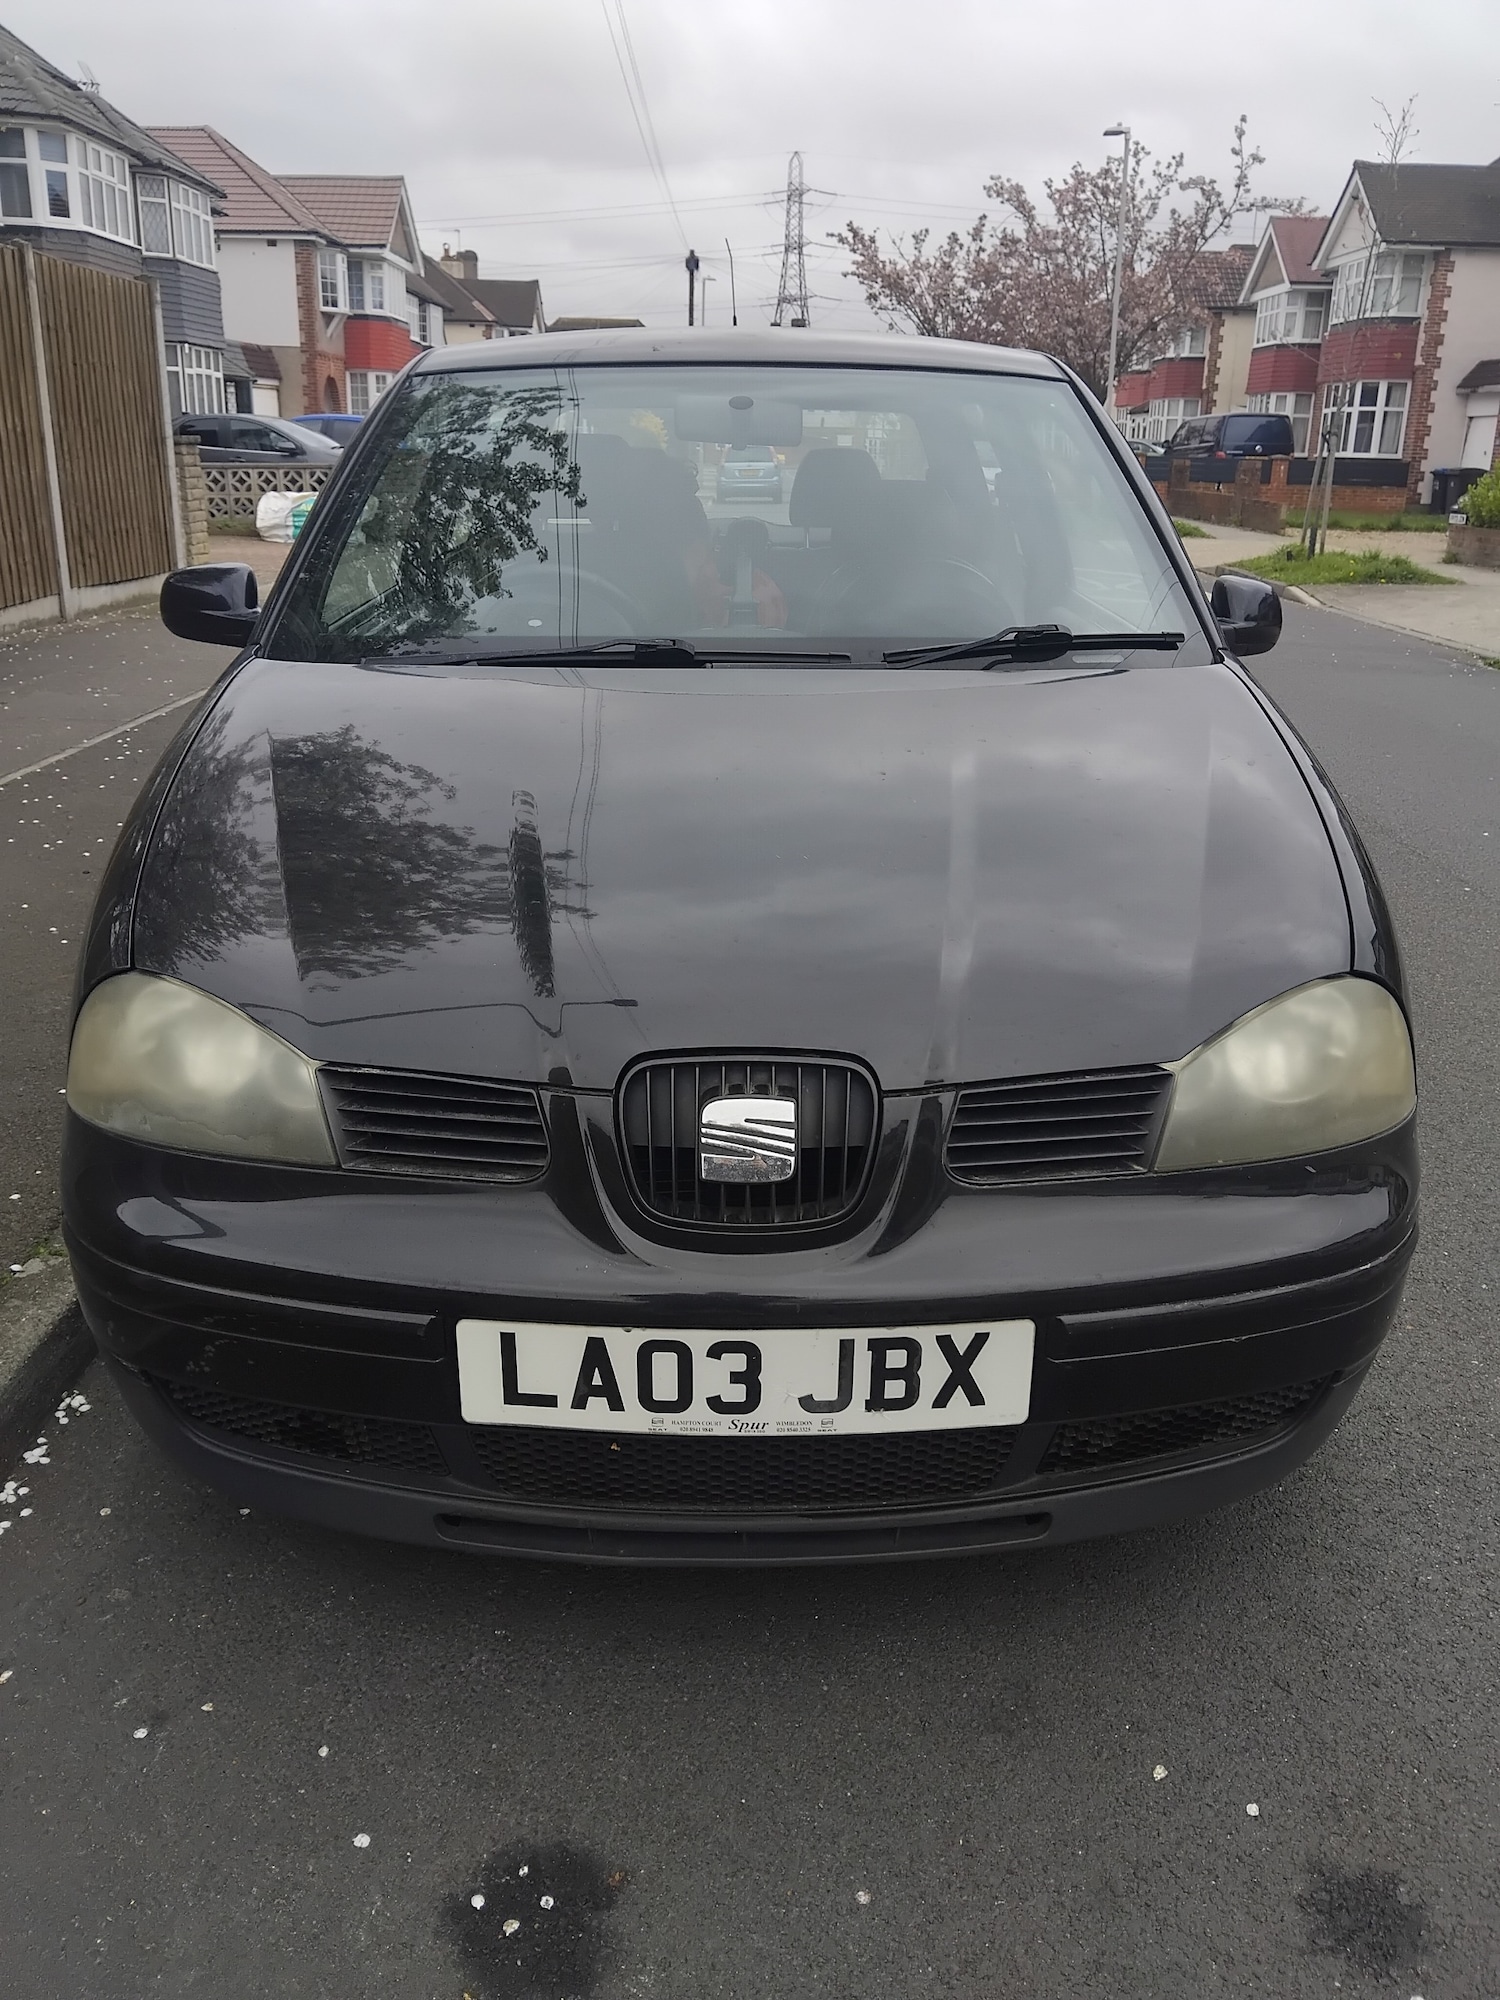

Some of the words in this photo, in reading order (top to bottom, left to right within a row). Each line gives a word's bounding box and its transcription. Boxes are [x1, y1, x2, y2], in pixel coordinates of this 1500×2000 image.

[499, 1331, 762, 1415] LA03
[797, 1331, 991, 1414] JBX
[728, 1418, 769, 1433] Spur
